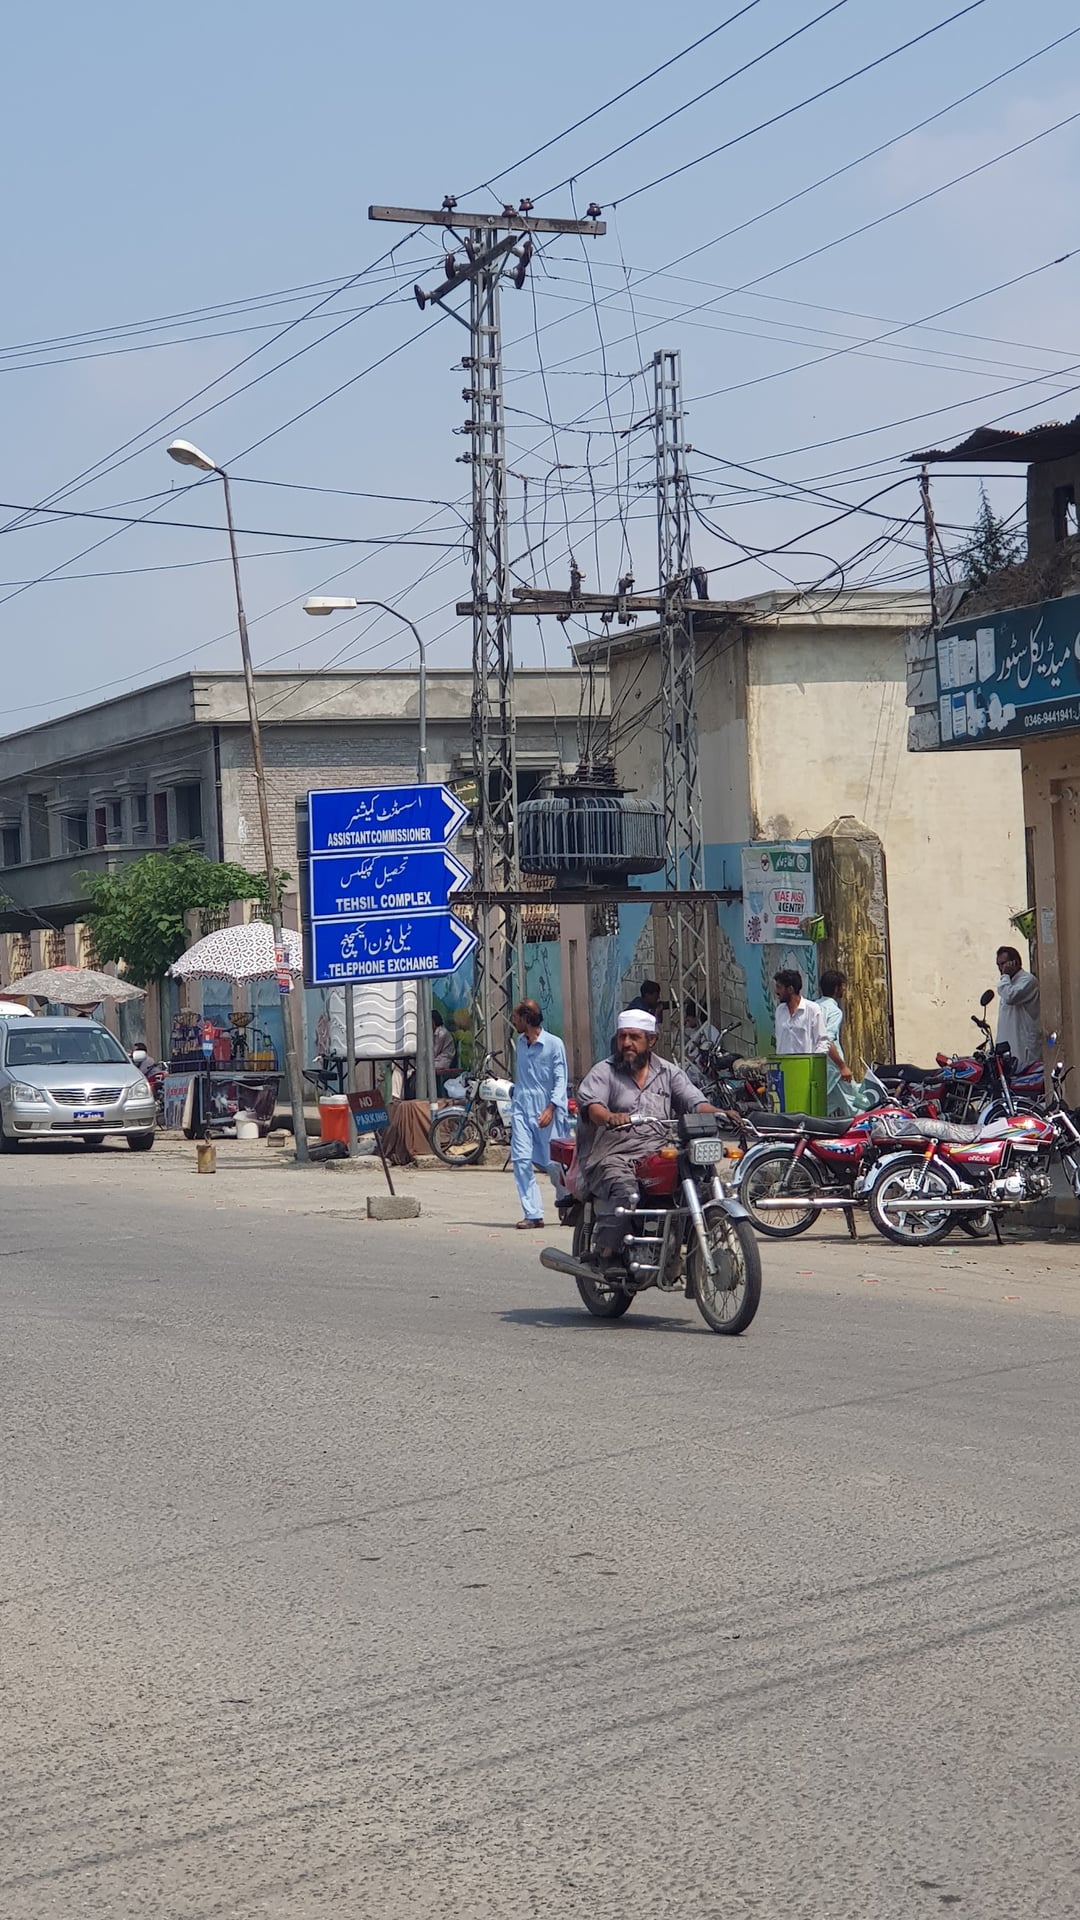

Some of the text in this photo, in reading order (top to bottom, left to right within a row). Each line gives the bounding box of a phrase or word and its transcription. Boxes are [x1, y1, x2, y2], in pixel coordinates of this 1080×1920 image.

[375, 856, 409, 889] تحصیل
[336, 891, 432, 912] TEHSIL COMPLEX
[329, 955, 439, 977] TELEPHONE EXCHANGE
[358, 1096, 373, 1108] NO
[355, 1111, 388, 1126] PARKING
